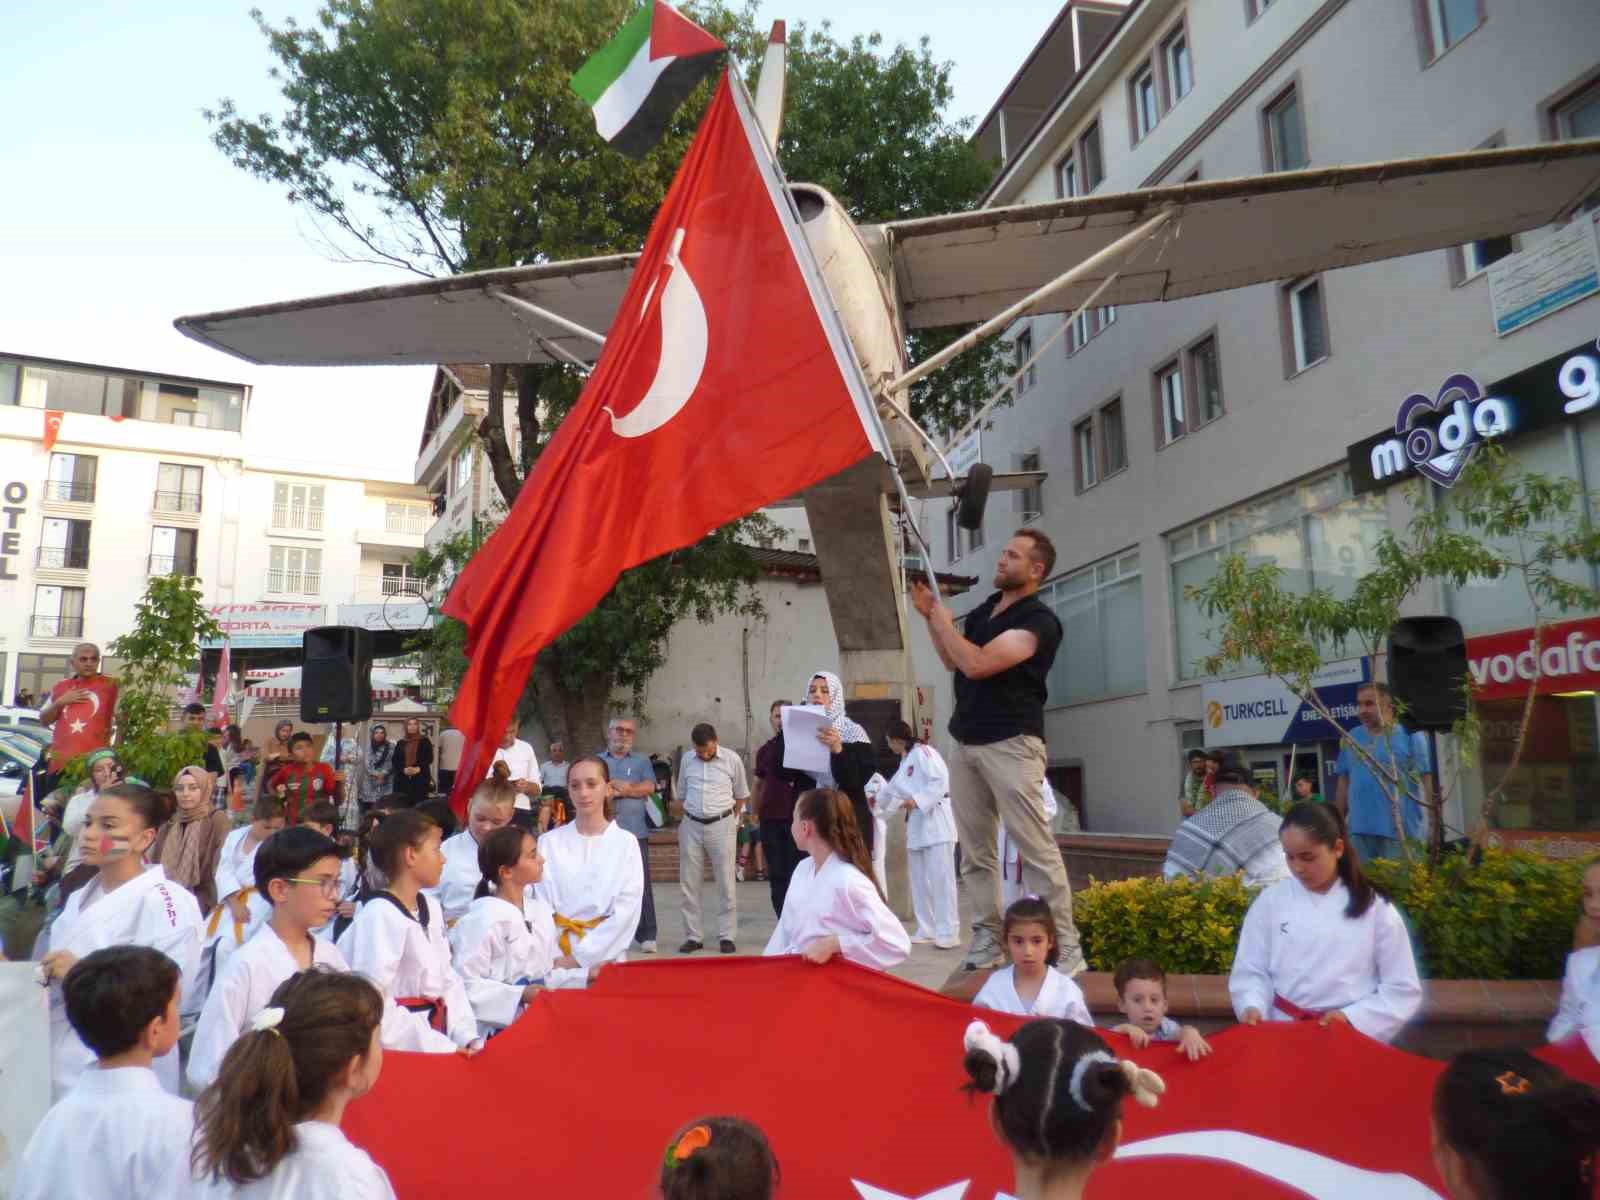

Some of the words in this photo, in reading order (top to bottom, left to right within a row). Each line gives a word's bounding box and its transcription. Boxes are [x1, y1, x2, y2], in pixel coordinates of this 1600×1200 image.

[1371, 398, 1508, 480] moda
[0, 481, 28, 580] OTEL
[1223, 698, 1289, 721] TURKCELL
